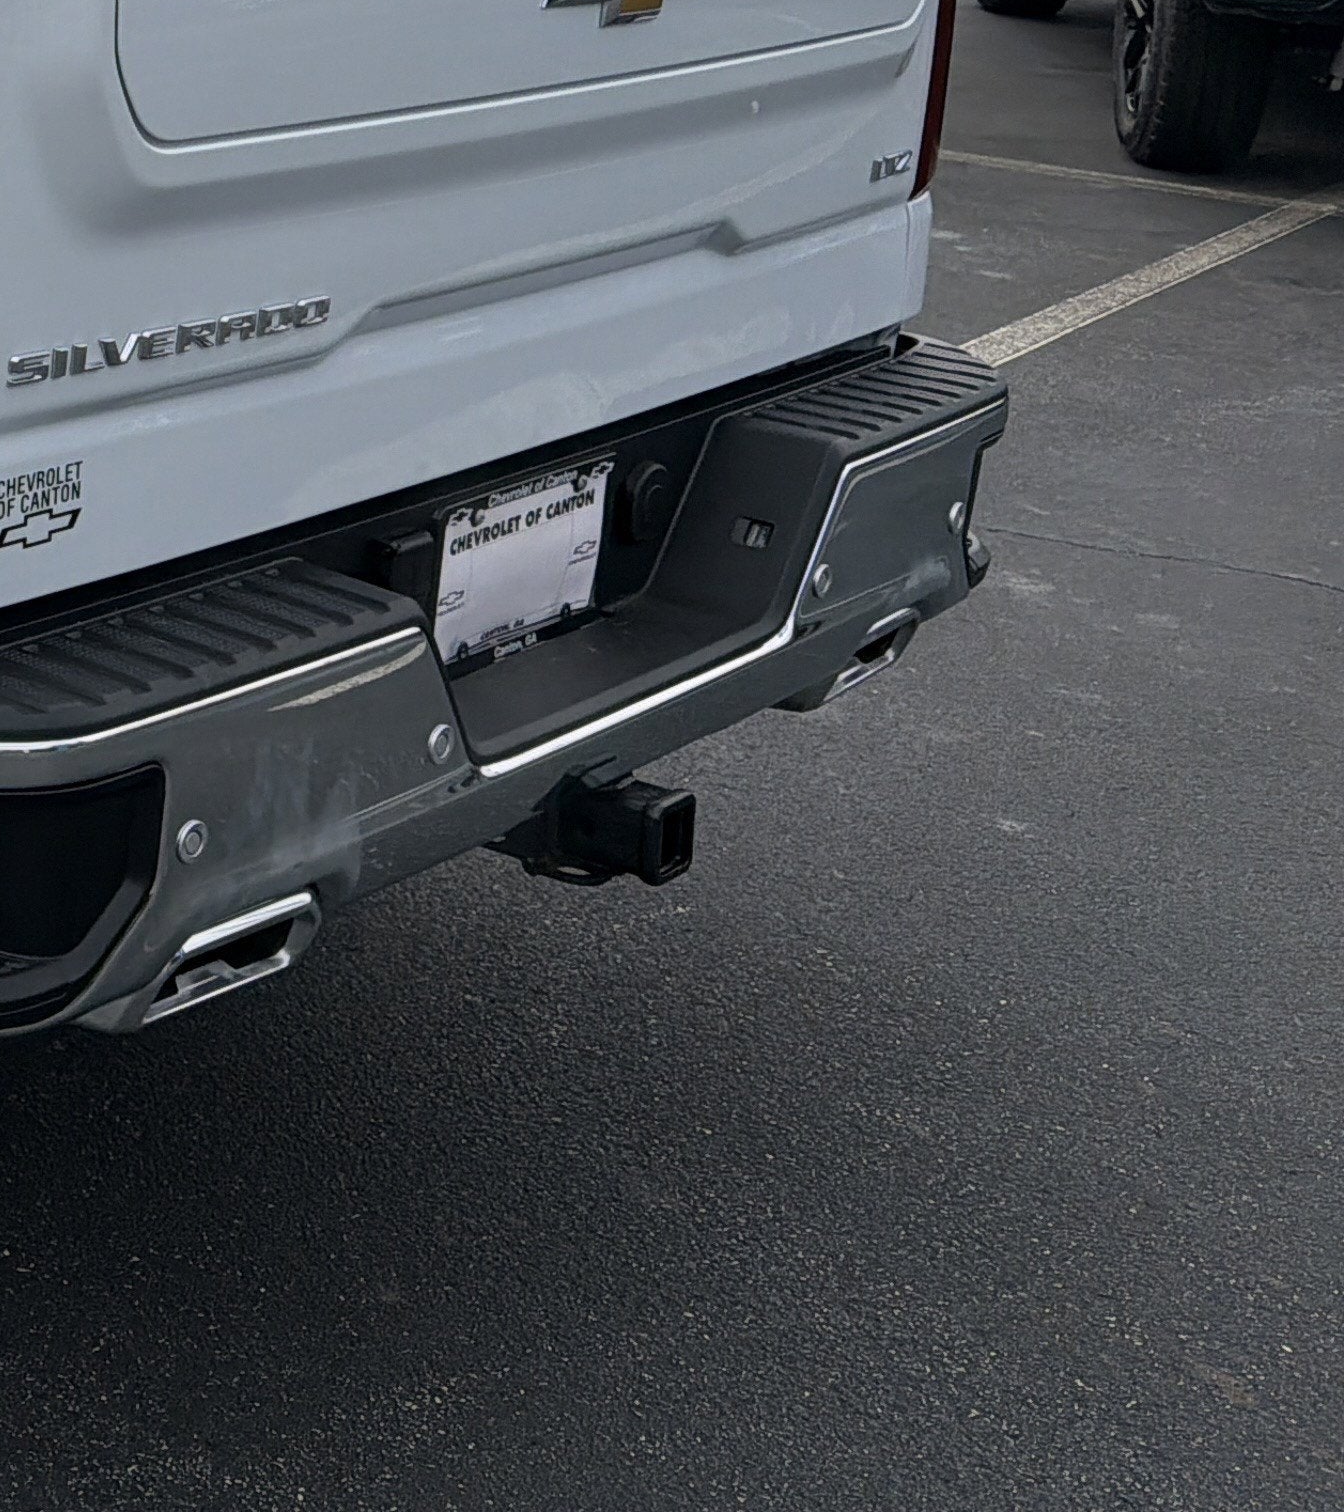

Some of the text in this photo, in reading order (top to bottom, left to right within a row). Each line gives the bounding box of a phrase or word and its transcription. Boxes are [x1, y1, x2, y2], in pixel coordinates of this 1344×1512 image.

[6, 294, 331, 388] SILVERADO
[20, 481, 82, 514] CANTON
[449, 489, 596, 556] CHEVROLET OF CANTON
